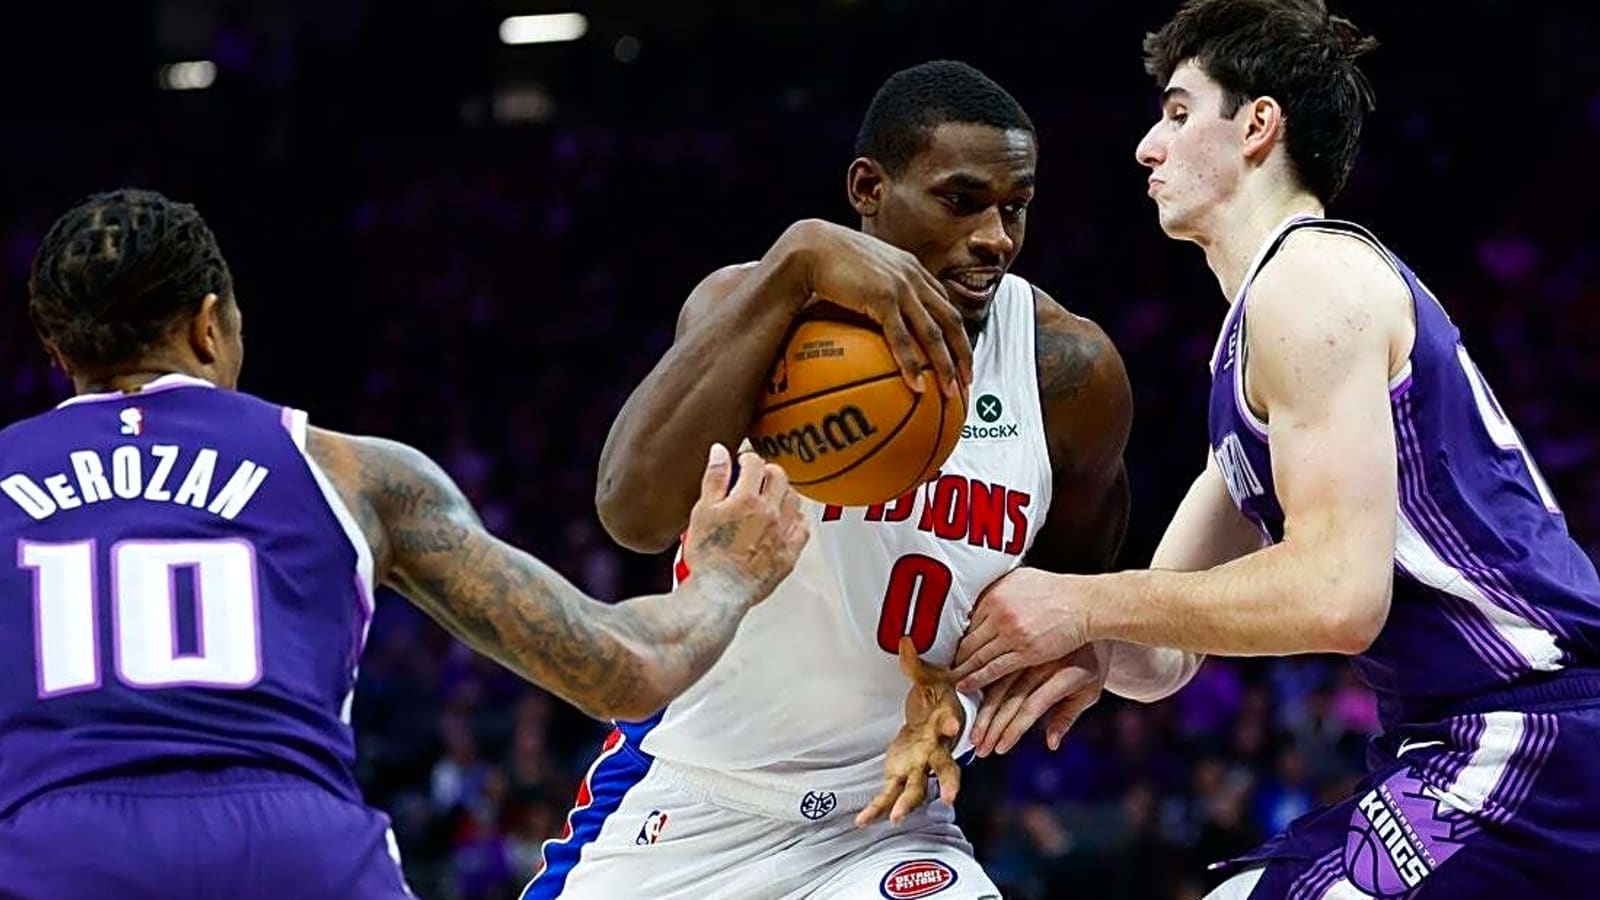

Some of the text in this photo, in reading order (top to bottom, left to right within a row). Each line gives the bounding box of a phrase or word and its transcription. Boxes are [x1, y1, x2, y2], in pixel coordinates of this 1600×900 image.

[960, 424, 1019, 439] StockX
[17, 537, 263, 699] 10
[877, 553, 953, 656] 0
[1359, 789, 1430, 888] KINGS
[895, 869, 941, 884] DETROIT
[895, 875, 942, 891] PISTONS
